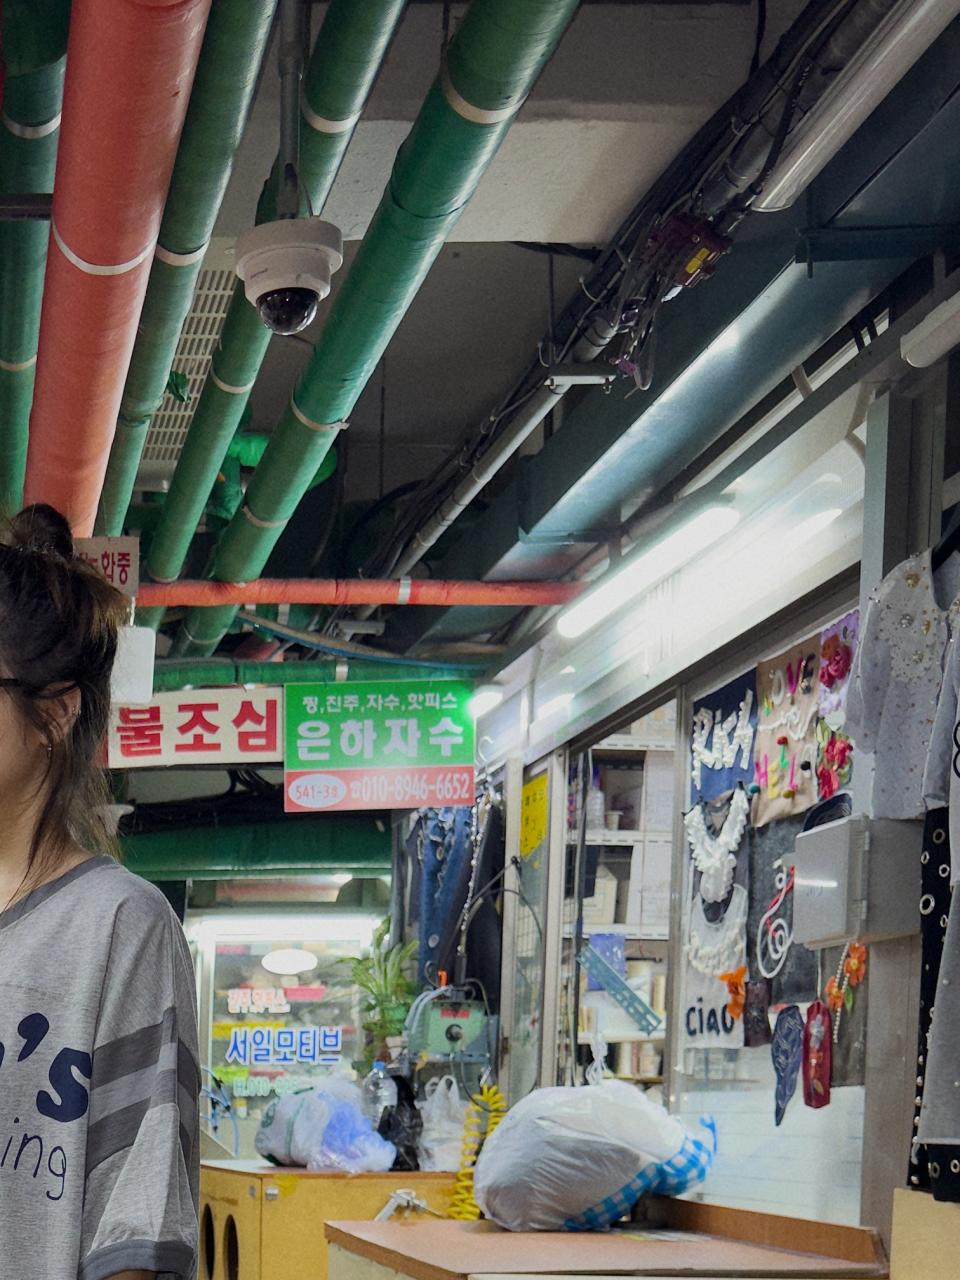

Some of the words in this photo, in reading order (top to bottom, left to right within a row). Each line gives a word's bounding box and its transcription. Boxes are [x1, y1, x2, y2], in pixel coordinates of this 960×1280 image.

[116, 698, 278, 758] 불조심
[296, 716, 464, 761] 은하자수
[362, 773, 470, 801] 010-8946-6652
[226, 1025, 341, 1064] 서일모티브
